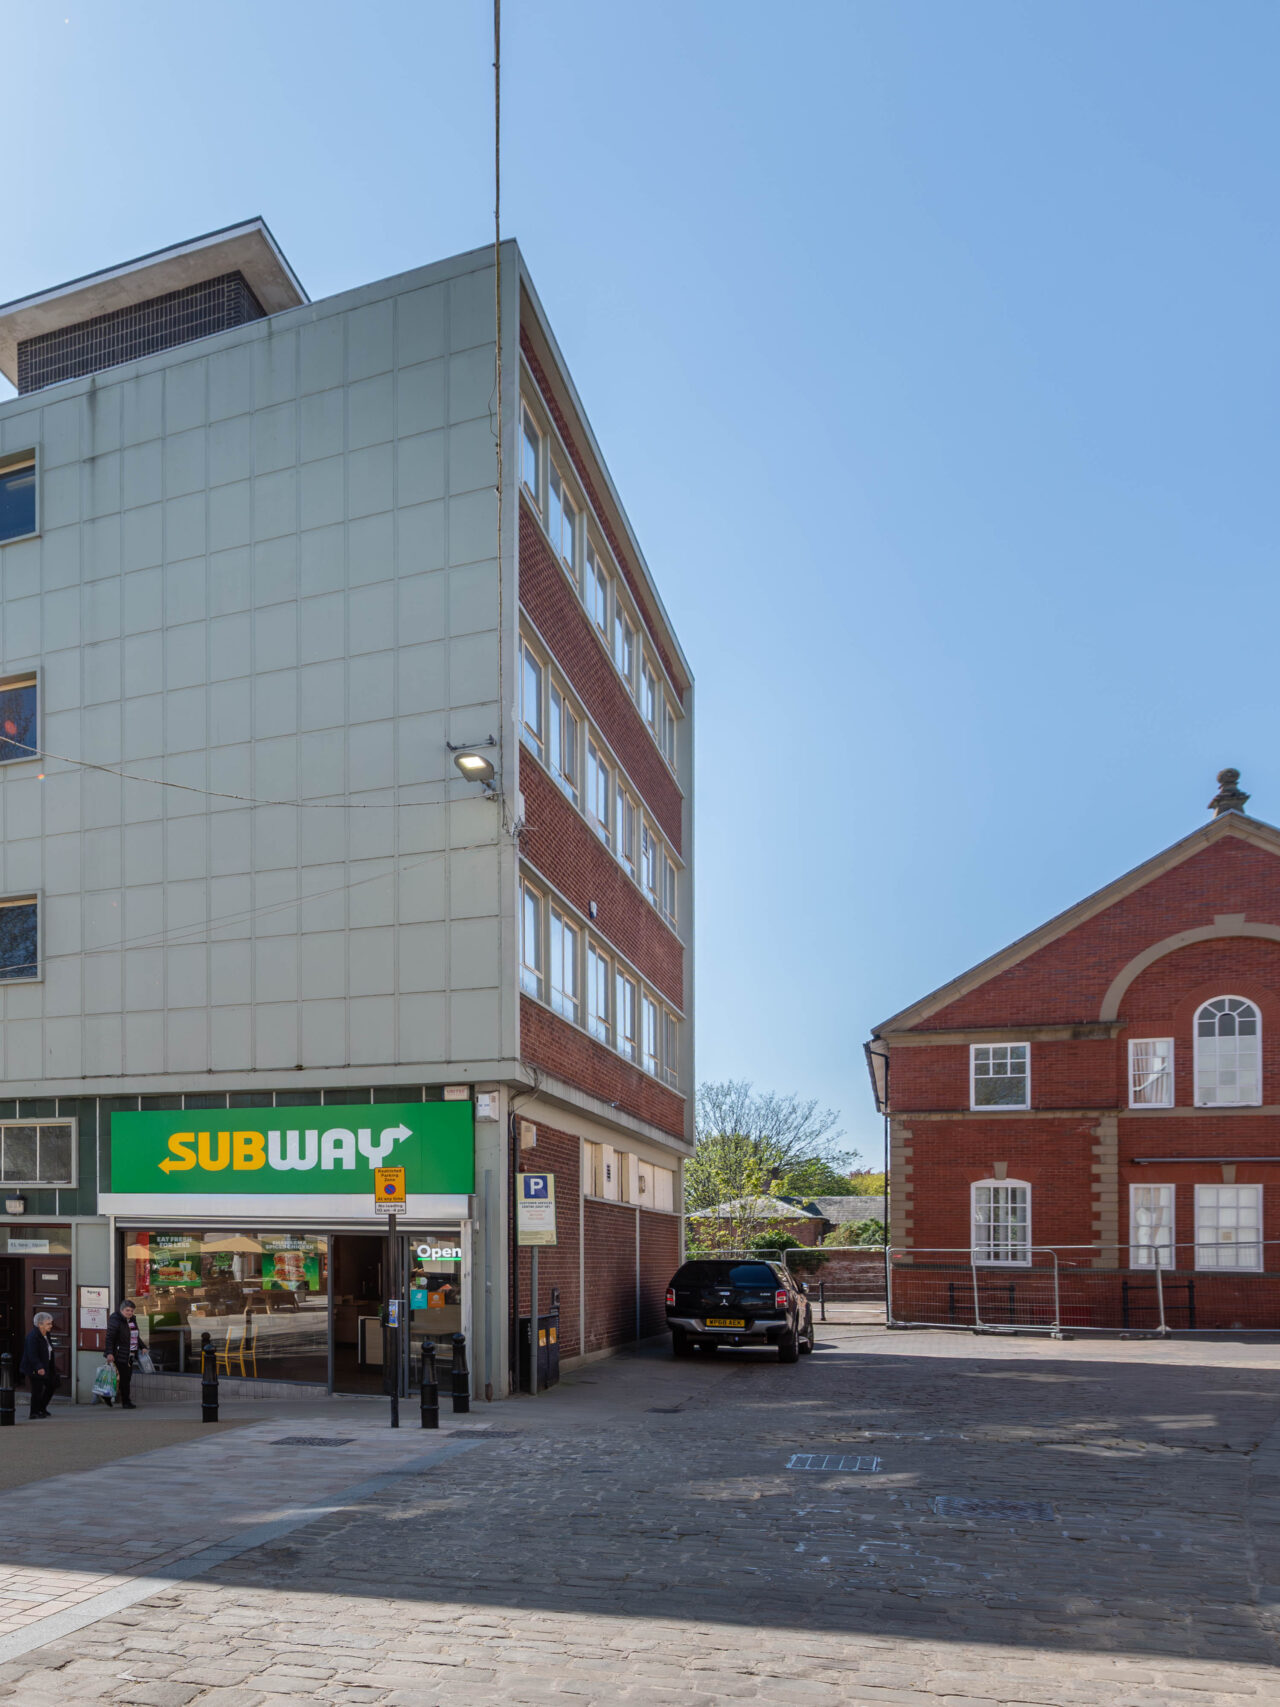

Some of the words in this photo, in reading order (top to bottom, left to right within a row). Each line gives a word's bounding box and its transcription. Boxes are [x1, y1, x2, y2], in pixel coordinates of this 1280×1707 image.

[157, 1123, 413, 1175] SUBWAY
[530, 1178, 544, 1195] P
[417, 1244, 462, 1261] Open
